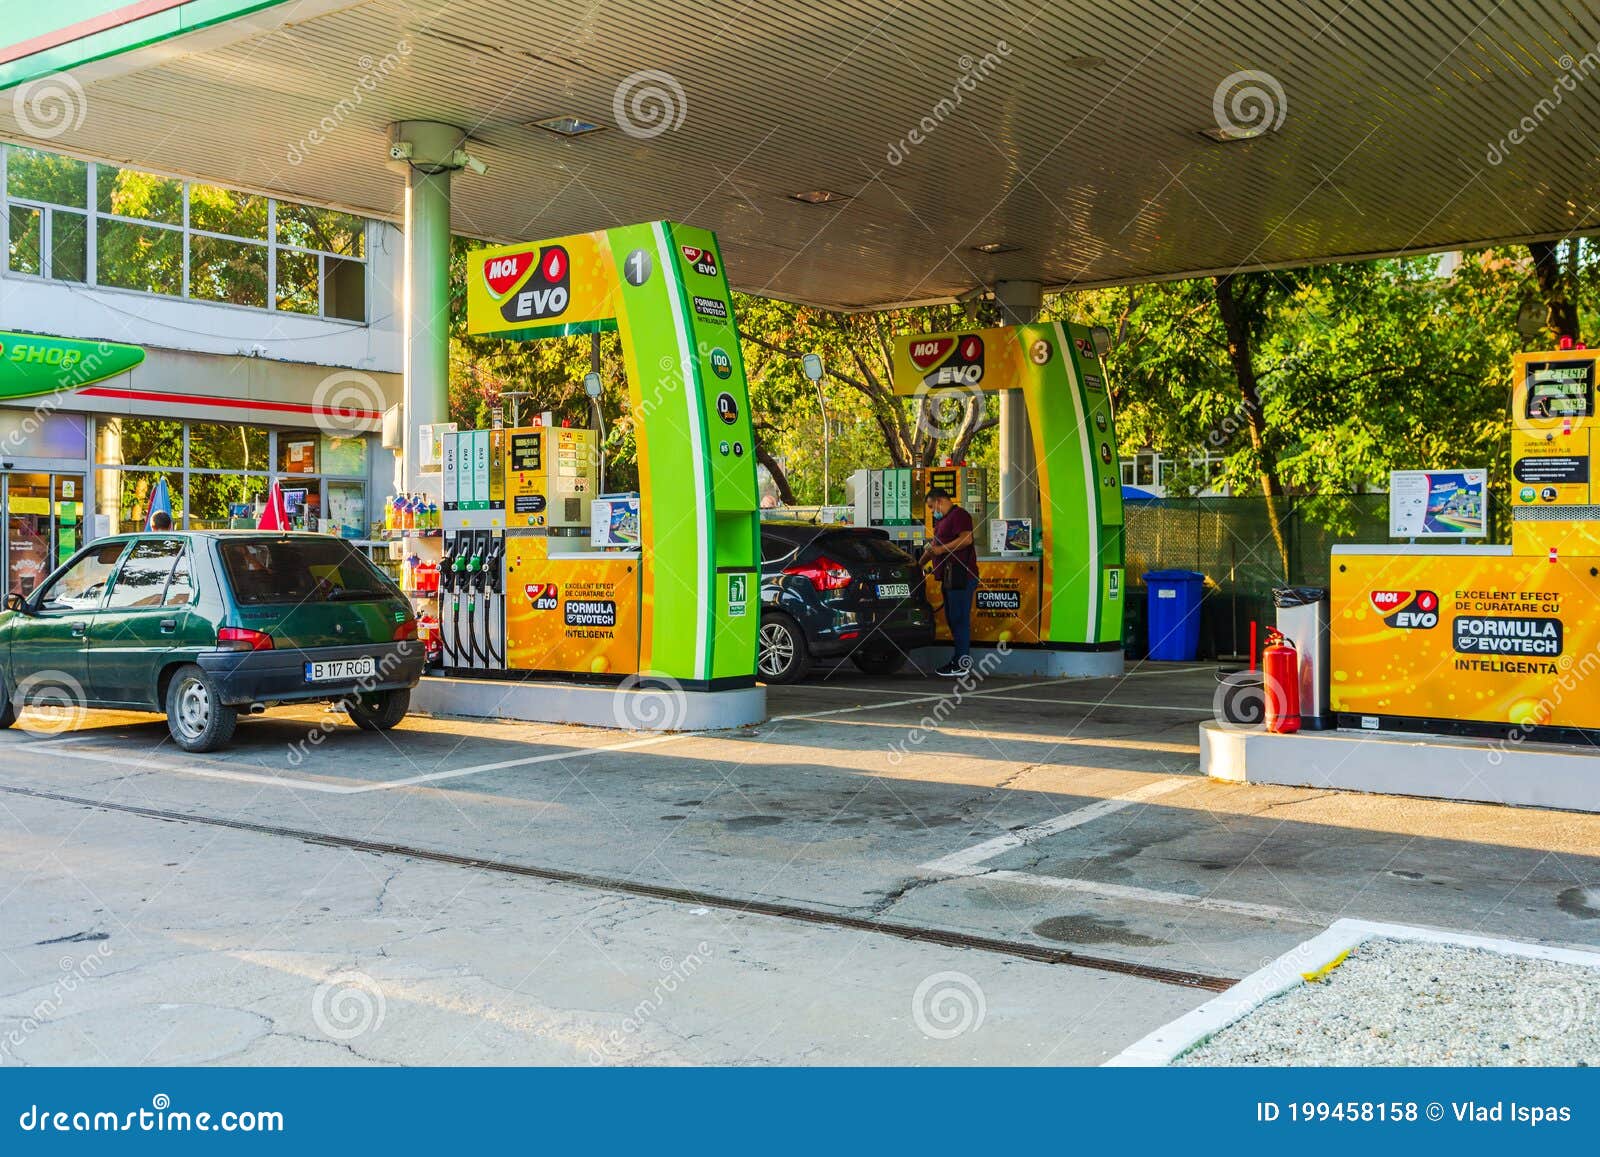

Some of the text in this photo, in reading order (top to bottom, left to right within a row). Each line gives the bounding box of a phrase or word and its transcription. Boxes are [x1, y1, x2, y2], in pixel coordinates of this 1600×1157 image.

[489, 259, 518, 280] MOL
[630, 251, 643, 284] 1
[698, 263, 717, 275] EVO
[516, 286, 568, 317] EVO
[694, 297, 725, 311] FORMULA
[10, 344, 82, 364] SHOP
[914, 342, 940, 358] MOL
[1034, 341, 1048, 364] 3
[713, 354, 728, 366] 100
[937, 364, 982, 385] EVO
[720, 399, 728, 412] D
[880, 585, 886, 595] B
[977, 592, 1018, 601] FORMULA
[1455, 590, 1560, 601] EXCELENT EFECT
[537, 598, 558, 609] EVO
[1375, 592, 1398, 603] MOL
[566, 602, 614, 614] FORMULA
[1455, 601, 1471, 610] DE
[1542, 603, 1560, 612] CU
[576, 615, 614, 625] EVOTECH
[1396, 612, 1438, 628] EVO
[1457, 619, 1557, 638] FORMULA
[1478, 637, 1557, 653] EVOTECH
[315, 664, 323, 678] B
[328, 663, 343, 677] 117
[346, 661, 371, 676] ROD
